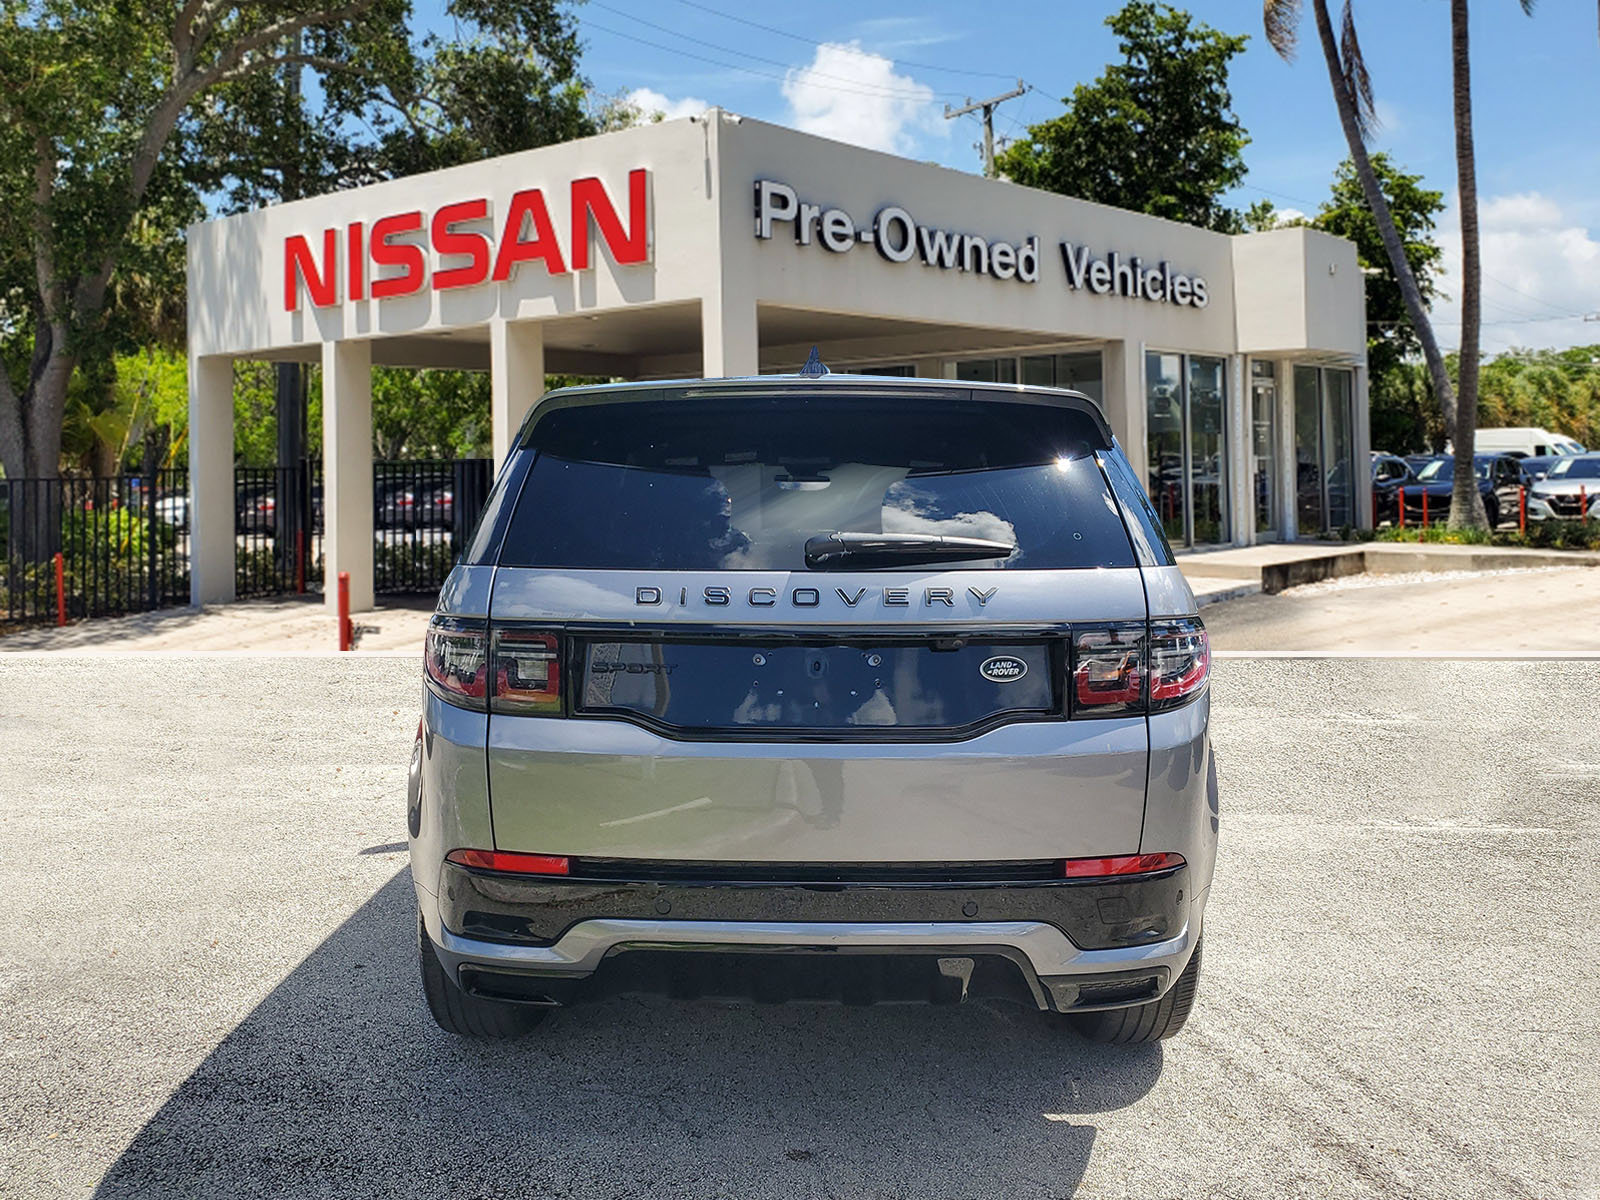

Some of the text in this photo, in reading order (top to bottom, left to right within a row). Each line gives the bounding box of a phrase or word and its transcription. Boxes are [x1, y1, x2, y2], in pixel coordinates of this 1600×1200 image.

[284, 168, 648, 312] NISSAN
[754, 179, 1208, 308] Pre-Owned Vehicles
[634, 586, 1000, 608] DISCOVERY
[591, 662, 679, 675] SPORT
[990, 661, 1012, 669] LAND
[992, 668, 1019, 676] ROVER
